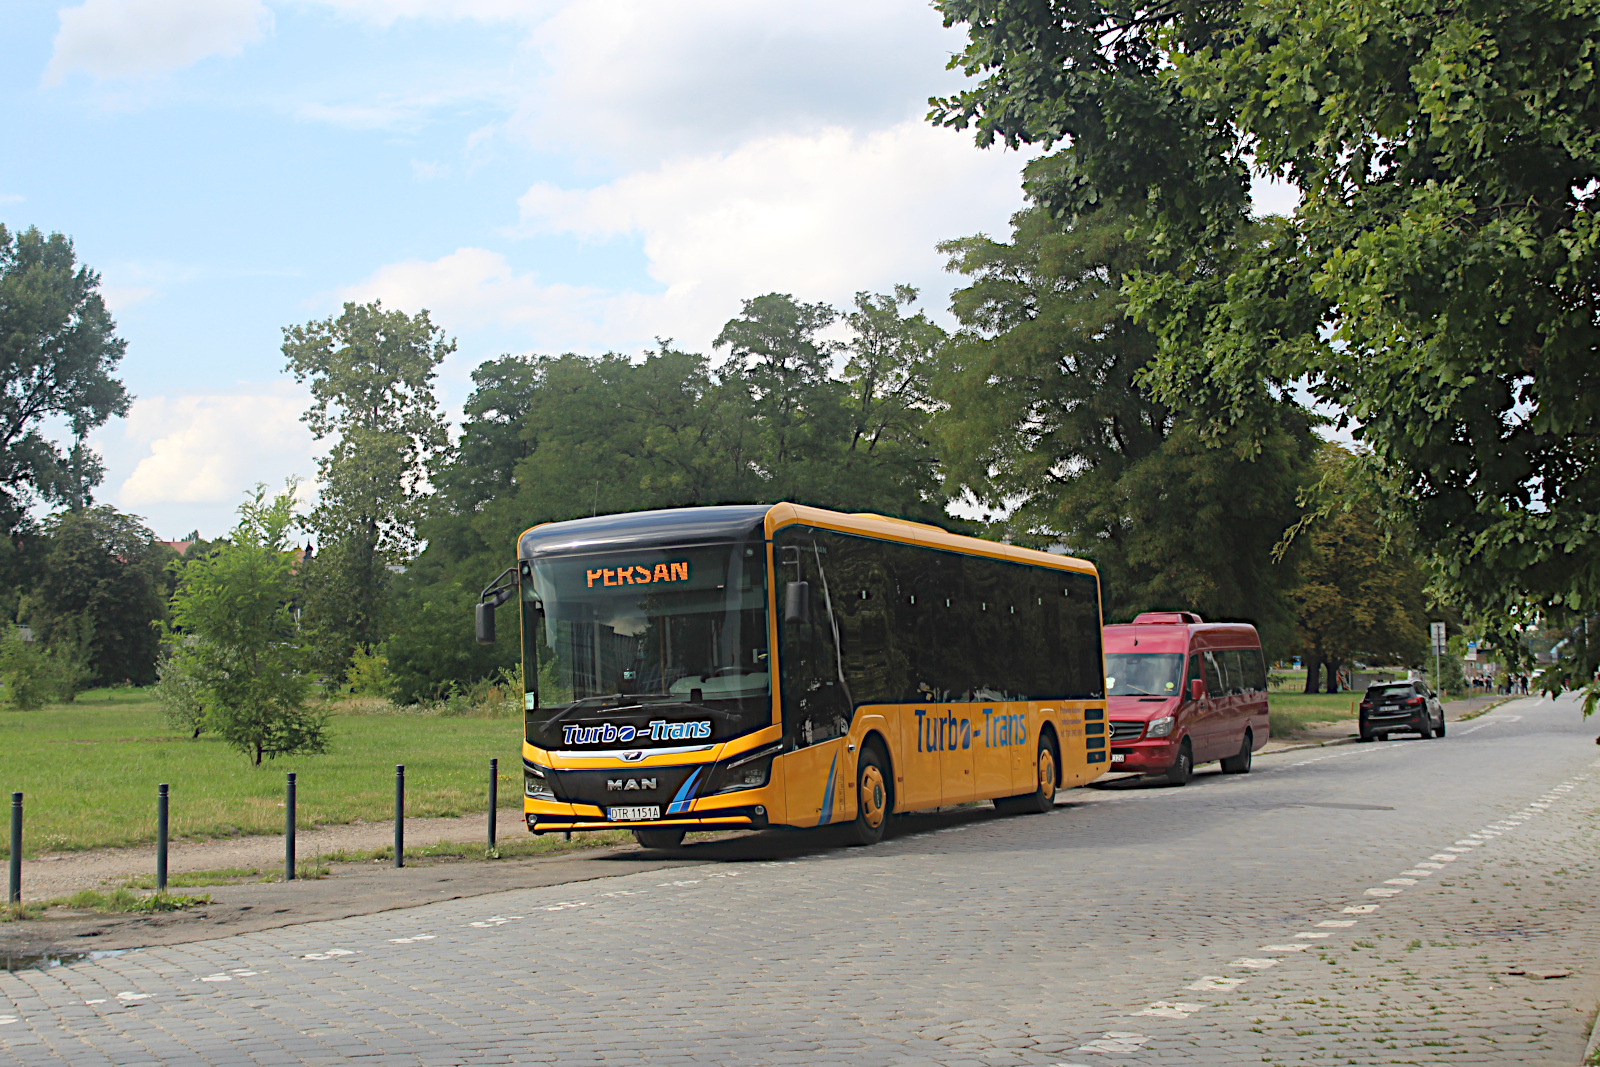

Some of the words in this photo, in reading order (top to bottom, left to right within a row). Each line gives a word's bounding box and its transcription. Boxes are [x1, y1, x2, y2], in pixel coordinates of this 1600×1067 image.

[586, 562, 689, 588] PERSAN
[562, 720, 711, 745] Turbo-Trans
[914, 708, 1027, 752] Turbo-Trans
[607, 777, 657, 791] MAN
[611, 808, 629, 819] DTR
[631, 807, 659, 818] 1151A
